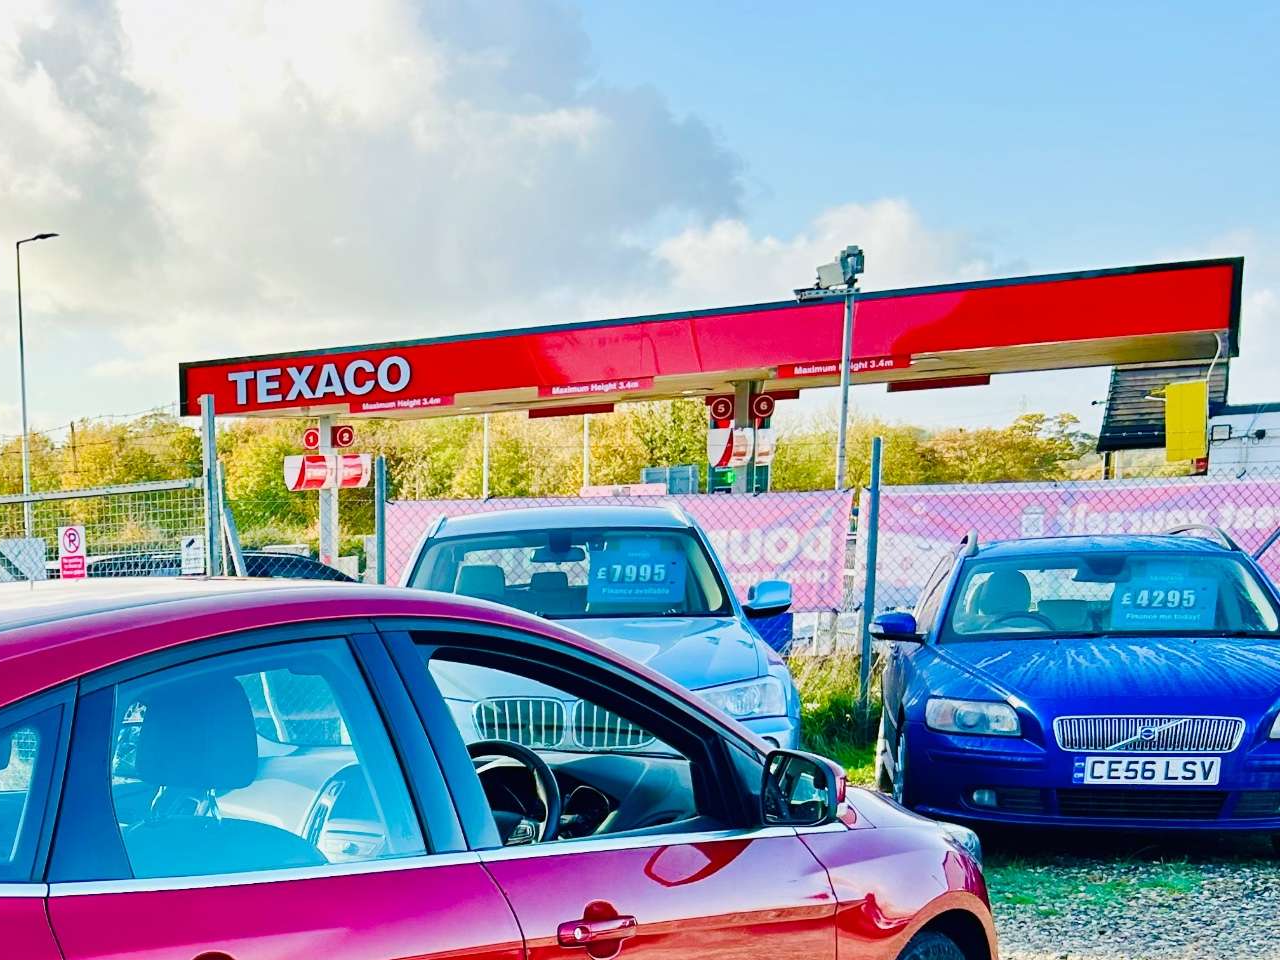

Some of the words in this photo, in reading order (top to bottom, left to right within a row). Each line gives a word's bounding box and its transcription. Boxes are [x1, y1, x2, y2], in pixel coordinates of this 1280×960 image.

[794, 364, 836, 375] Maximum
[839, 360, 867, 372] ight
[869, 359, 893, 368] 3.4m
[227, 355, 411, 405] TEXACO
[551, 385, 588, 395] Maximum
[590, 382, 616, 393] Height
[618, 380, 639, 390] 3.4m
[362, 400, 396, 411] Maximum
[397, 398, 421, 409] Height
[422, 396, 441, 405] 3.4m
[717, 403, 725, 413] 5
[760, 401, 768, 411] 6
[1090, 760, 1157, 781] CE56
[1163, 760, 1215, 781] LSV
